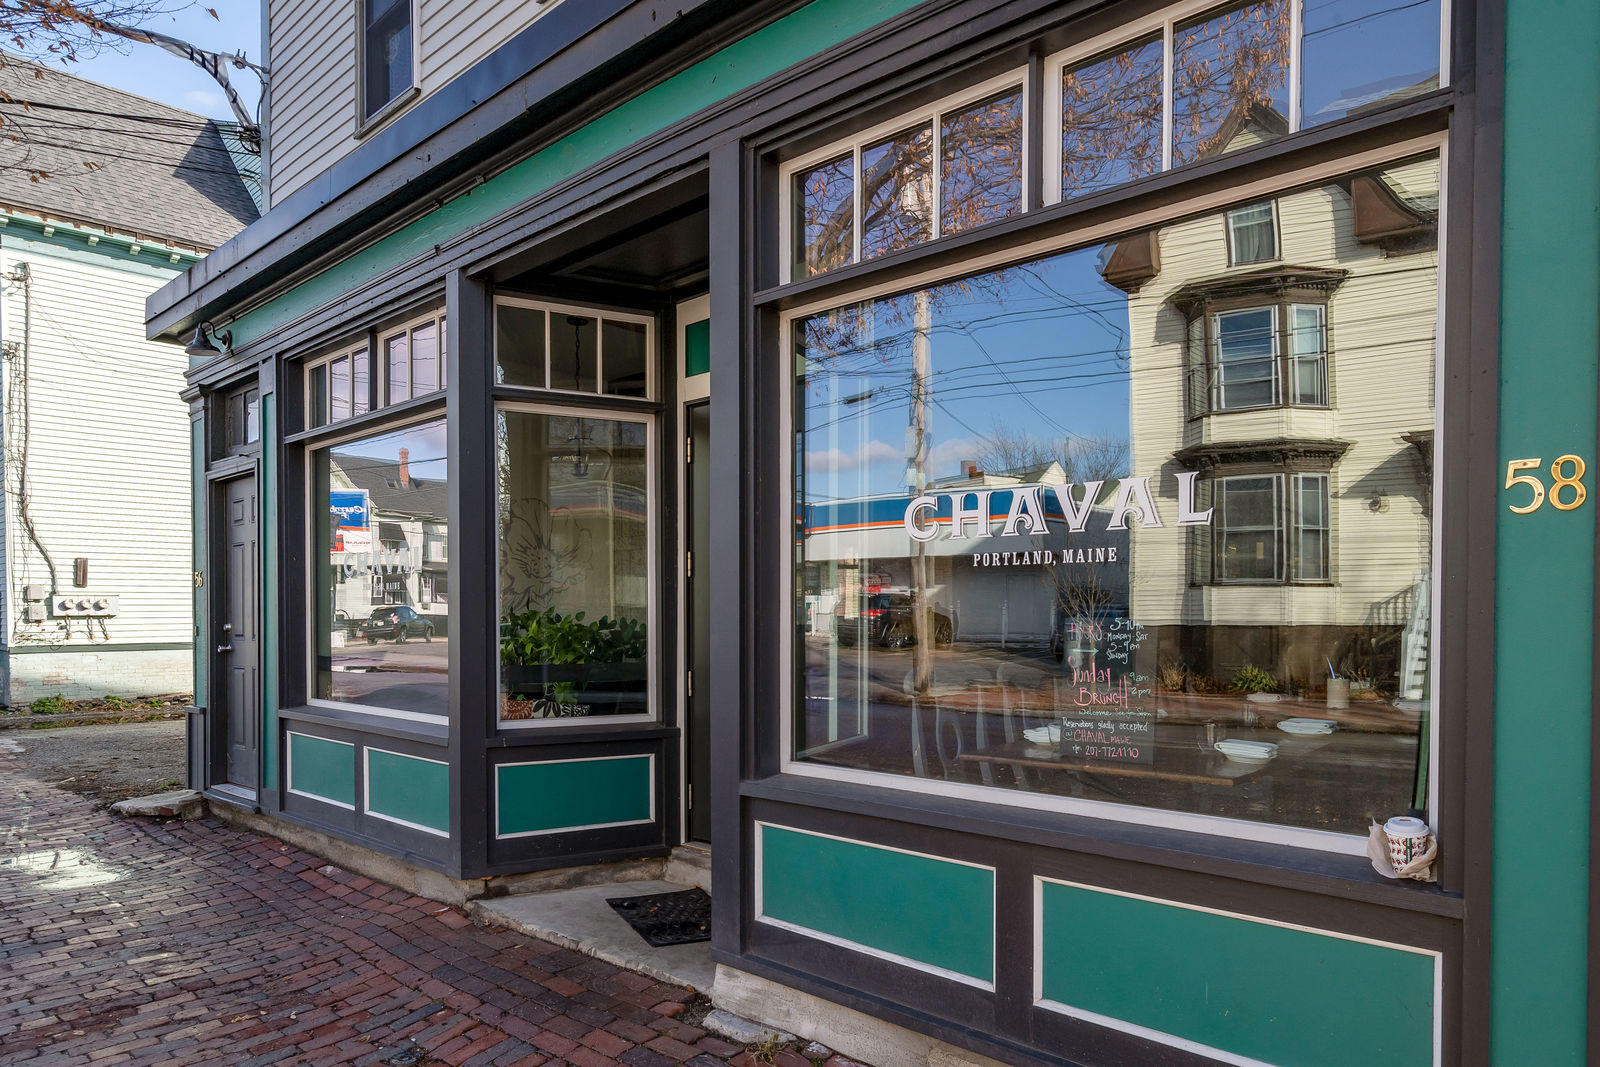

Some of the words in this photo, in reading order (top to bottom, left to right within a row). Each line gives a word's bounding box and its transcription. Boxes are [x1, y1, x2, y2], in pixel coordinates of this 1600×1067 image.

[1505, 454, 1587, 515] 58
[904, 471, 1214, 543] CHAVAL
[343, 546, 423, 578] CHAVAL
[973, 551, 1057, 568] PORTLAND,
[1062, 547, 1118, 565] MAINE
[194, 570, 204, 588] 56
[1119, 722, 1148, 733] accepted
